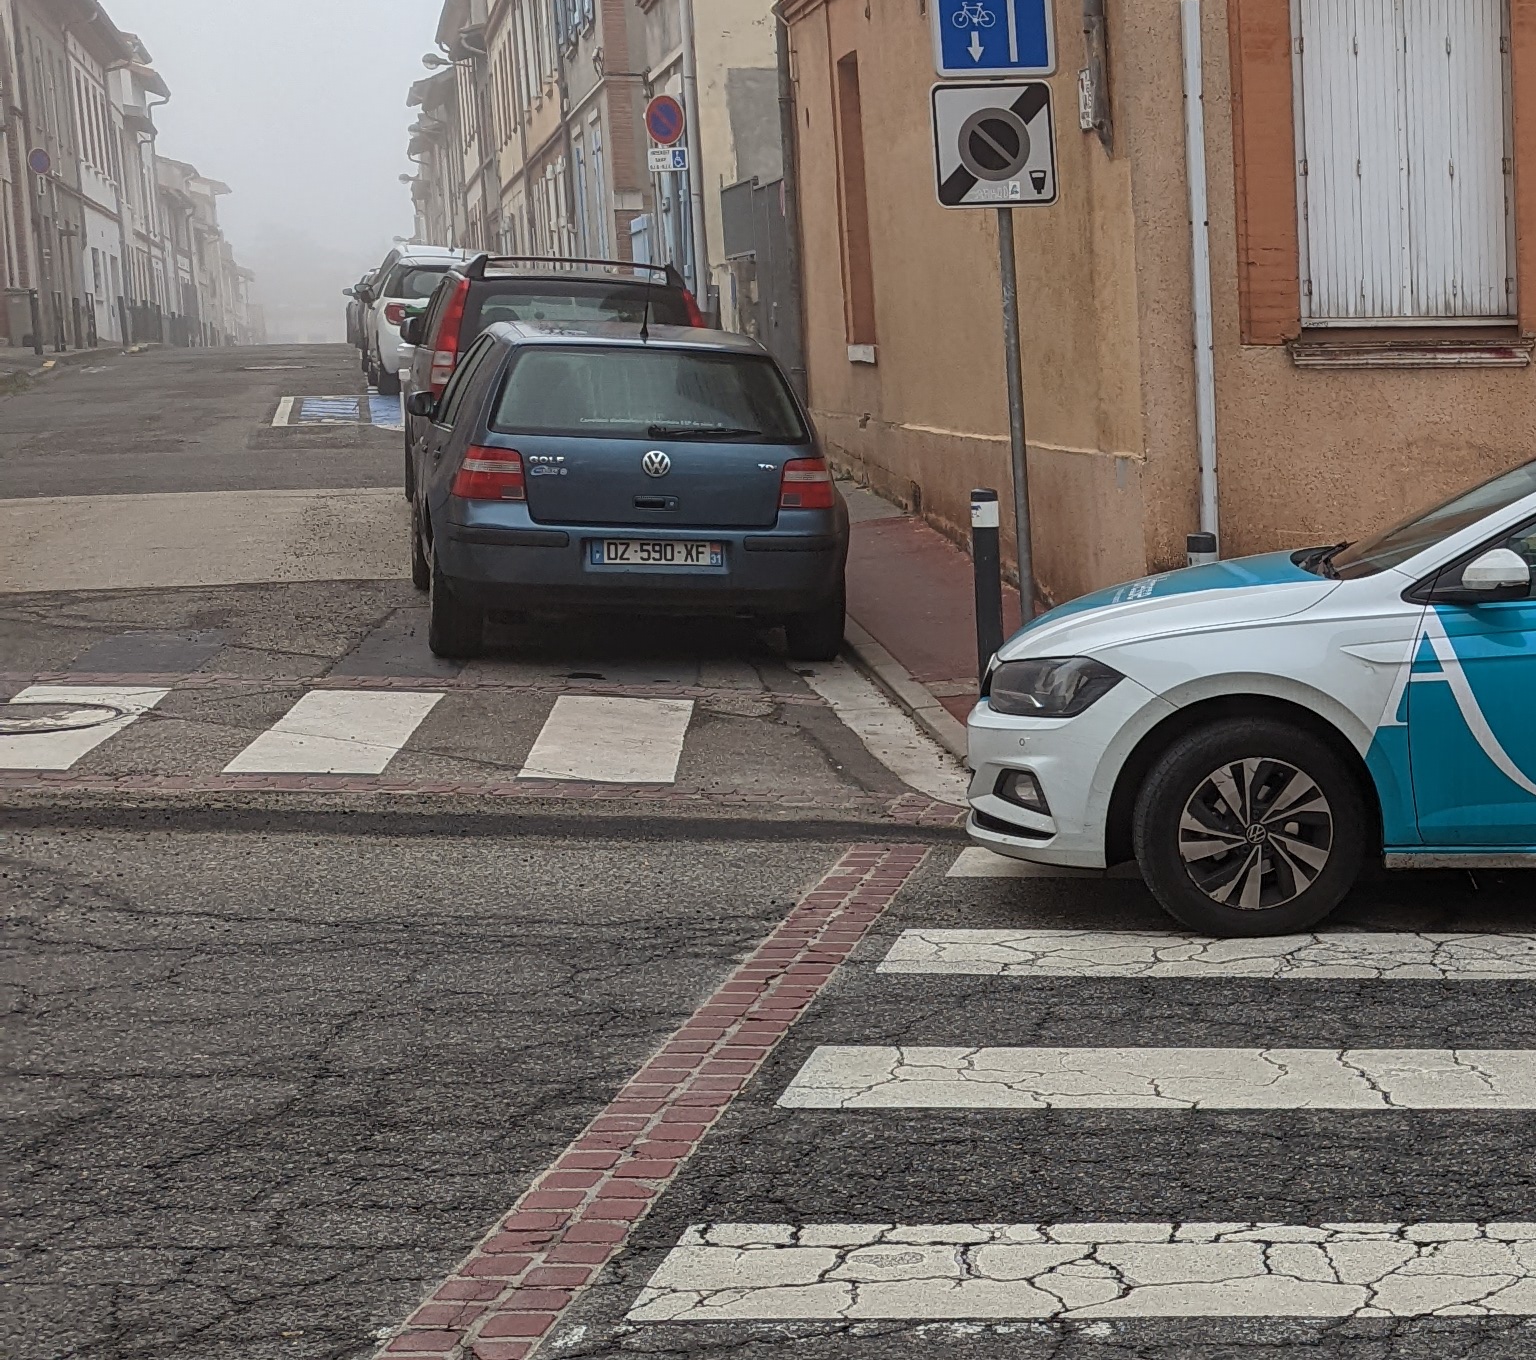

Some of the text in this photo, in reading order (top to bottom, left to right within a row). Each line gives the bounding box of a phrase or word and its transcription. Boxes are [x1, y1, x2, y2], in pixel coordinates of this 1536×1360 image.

[529, 455, 565, 464] GOLF
[606, 541, 707, 563] DZ-590-XF
[710, 553, 721, 564] 31
